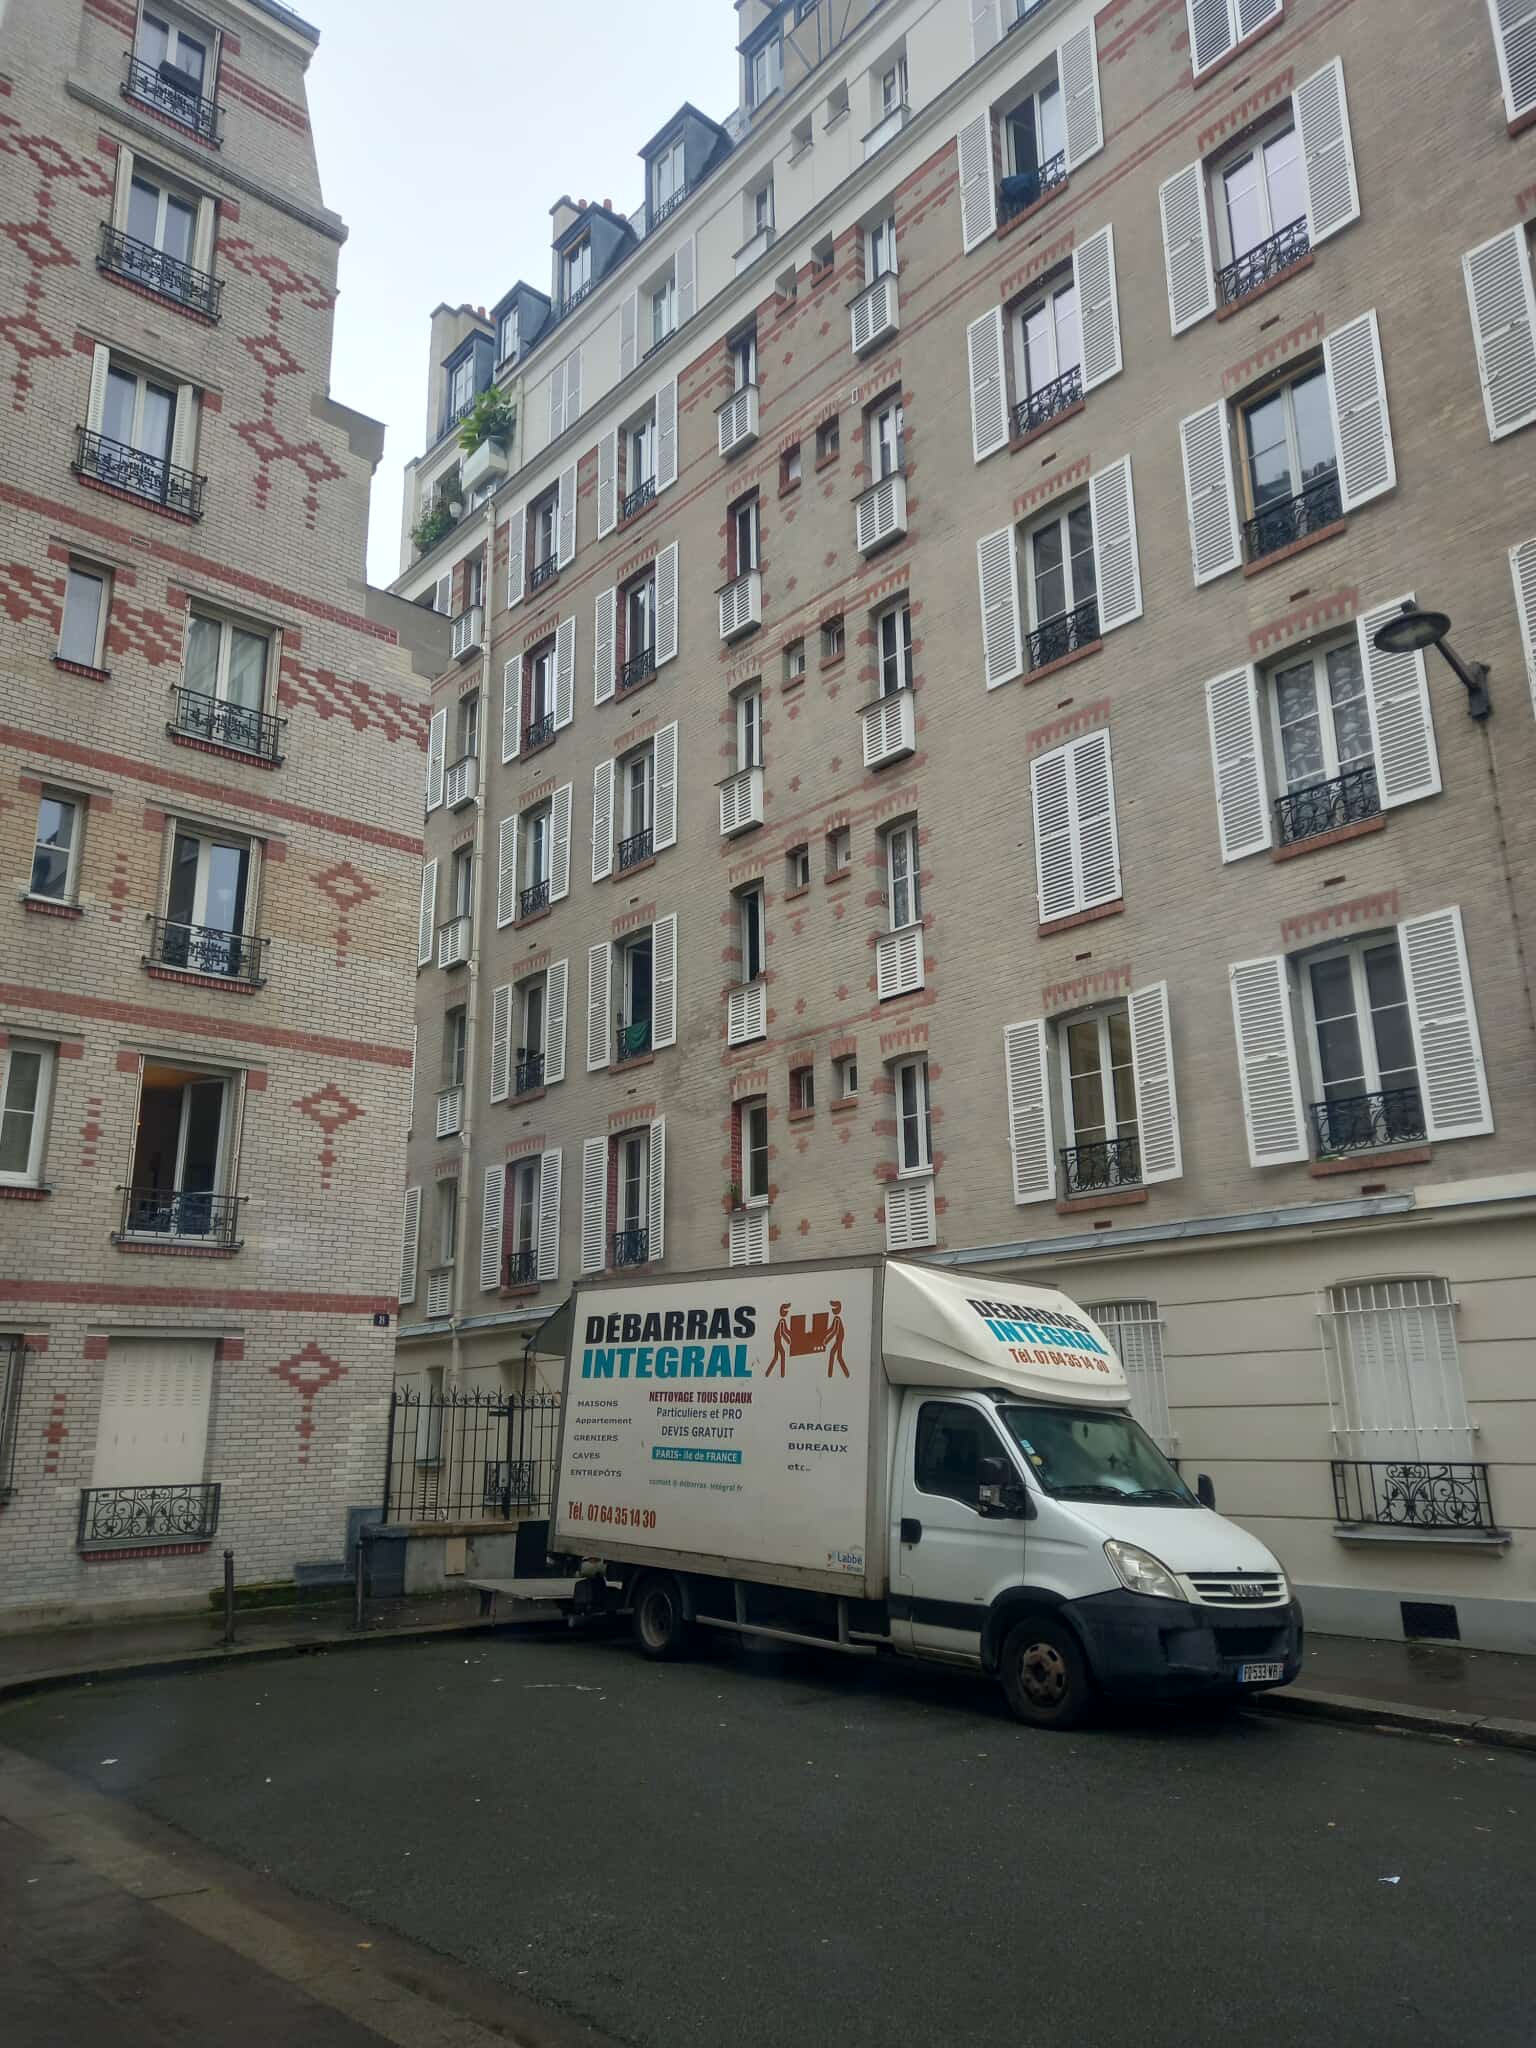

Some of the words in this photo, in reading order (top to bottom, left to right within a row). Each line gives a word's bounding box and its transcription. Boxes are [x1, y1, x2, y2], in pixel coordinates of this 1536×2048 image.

[585, 1306, 756, 1344] DÉBARRAS
[984, 1319, 1110, 1356] INTEGRAL
[581, 1344, 752, 1378] INTEGRAL
[1008, 1348, 1036, 1364] Tél.
[1033, 1350, 1050, 1365] 07
[1049, 1351, 1067, 1366] 64
[1063, 1352, 1082, 1368] 35
[1080, 1355, 1095, 1370] 14
[1093, 1358, 1110, 1374] 30
[577, 1399, 619, 1408] MAISONS
[649, 1392, 694, 1403] NETTOYAGE
[697, 1392, 718, 1403] TOUS
[719, 1392, 752, 1404] LOCAUX
[657, 1408, 707, 1419] Particuliers
[710, 1409, 720, 1419] et
[722, 1409, 742, 1420] PRO
[575, 1417, 632, 1425] Appartement
[661, 1425, 689, 1437] DEVIS
[692, 1426, 734, 1438] GRATUIT
[789, 1422, 849, 1433] GARAGES
[573, 1434, 619, 1442] GRENIERS
[788, 1442, 848, 1453] BUREAUX
[572, 1452, 601, 1460] CAVES
[694, 1450, 705, 1461] de
[706, 1451, 737, 1462] FRANCE
[569, 1501, 584, 1521] Tél.
[587, 1503, 599, 1522] 07
[600, 1505, 613, 1524] 64
[614, 1507, 628, 1526] 35
[630, 1508, 641, 1527] 14
[642, 1509, 656, 1529] 30
